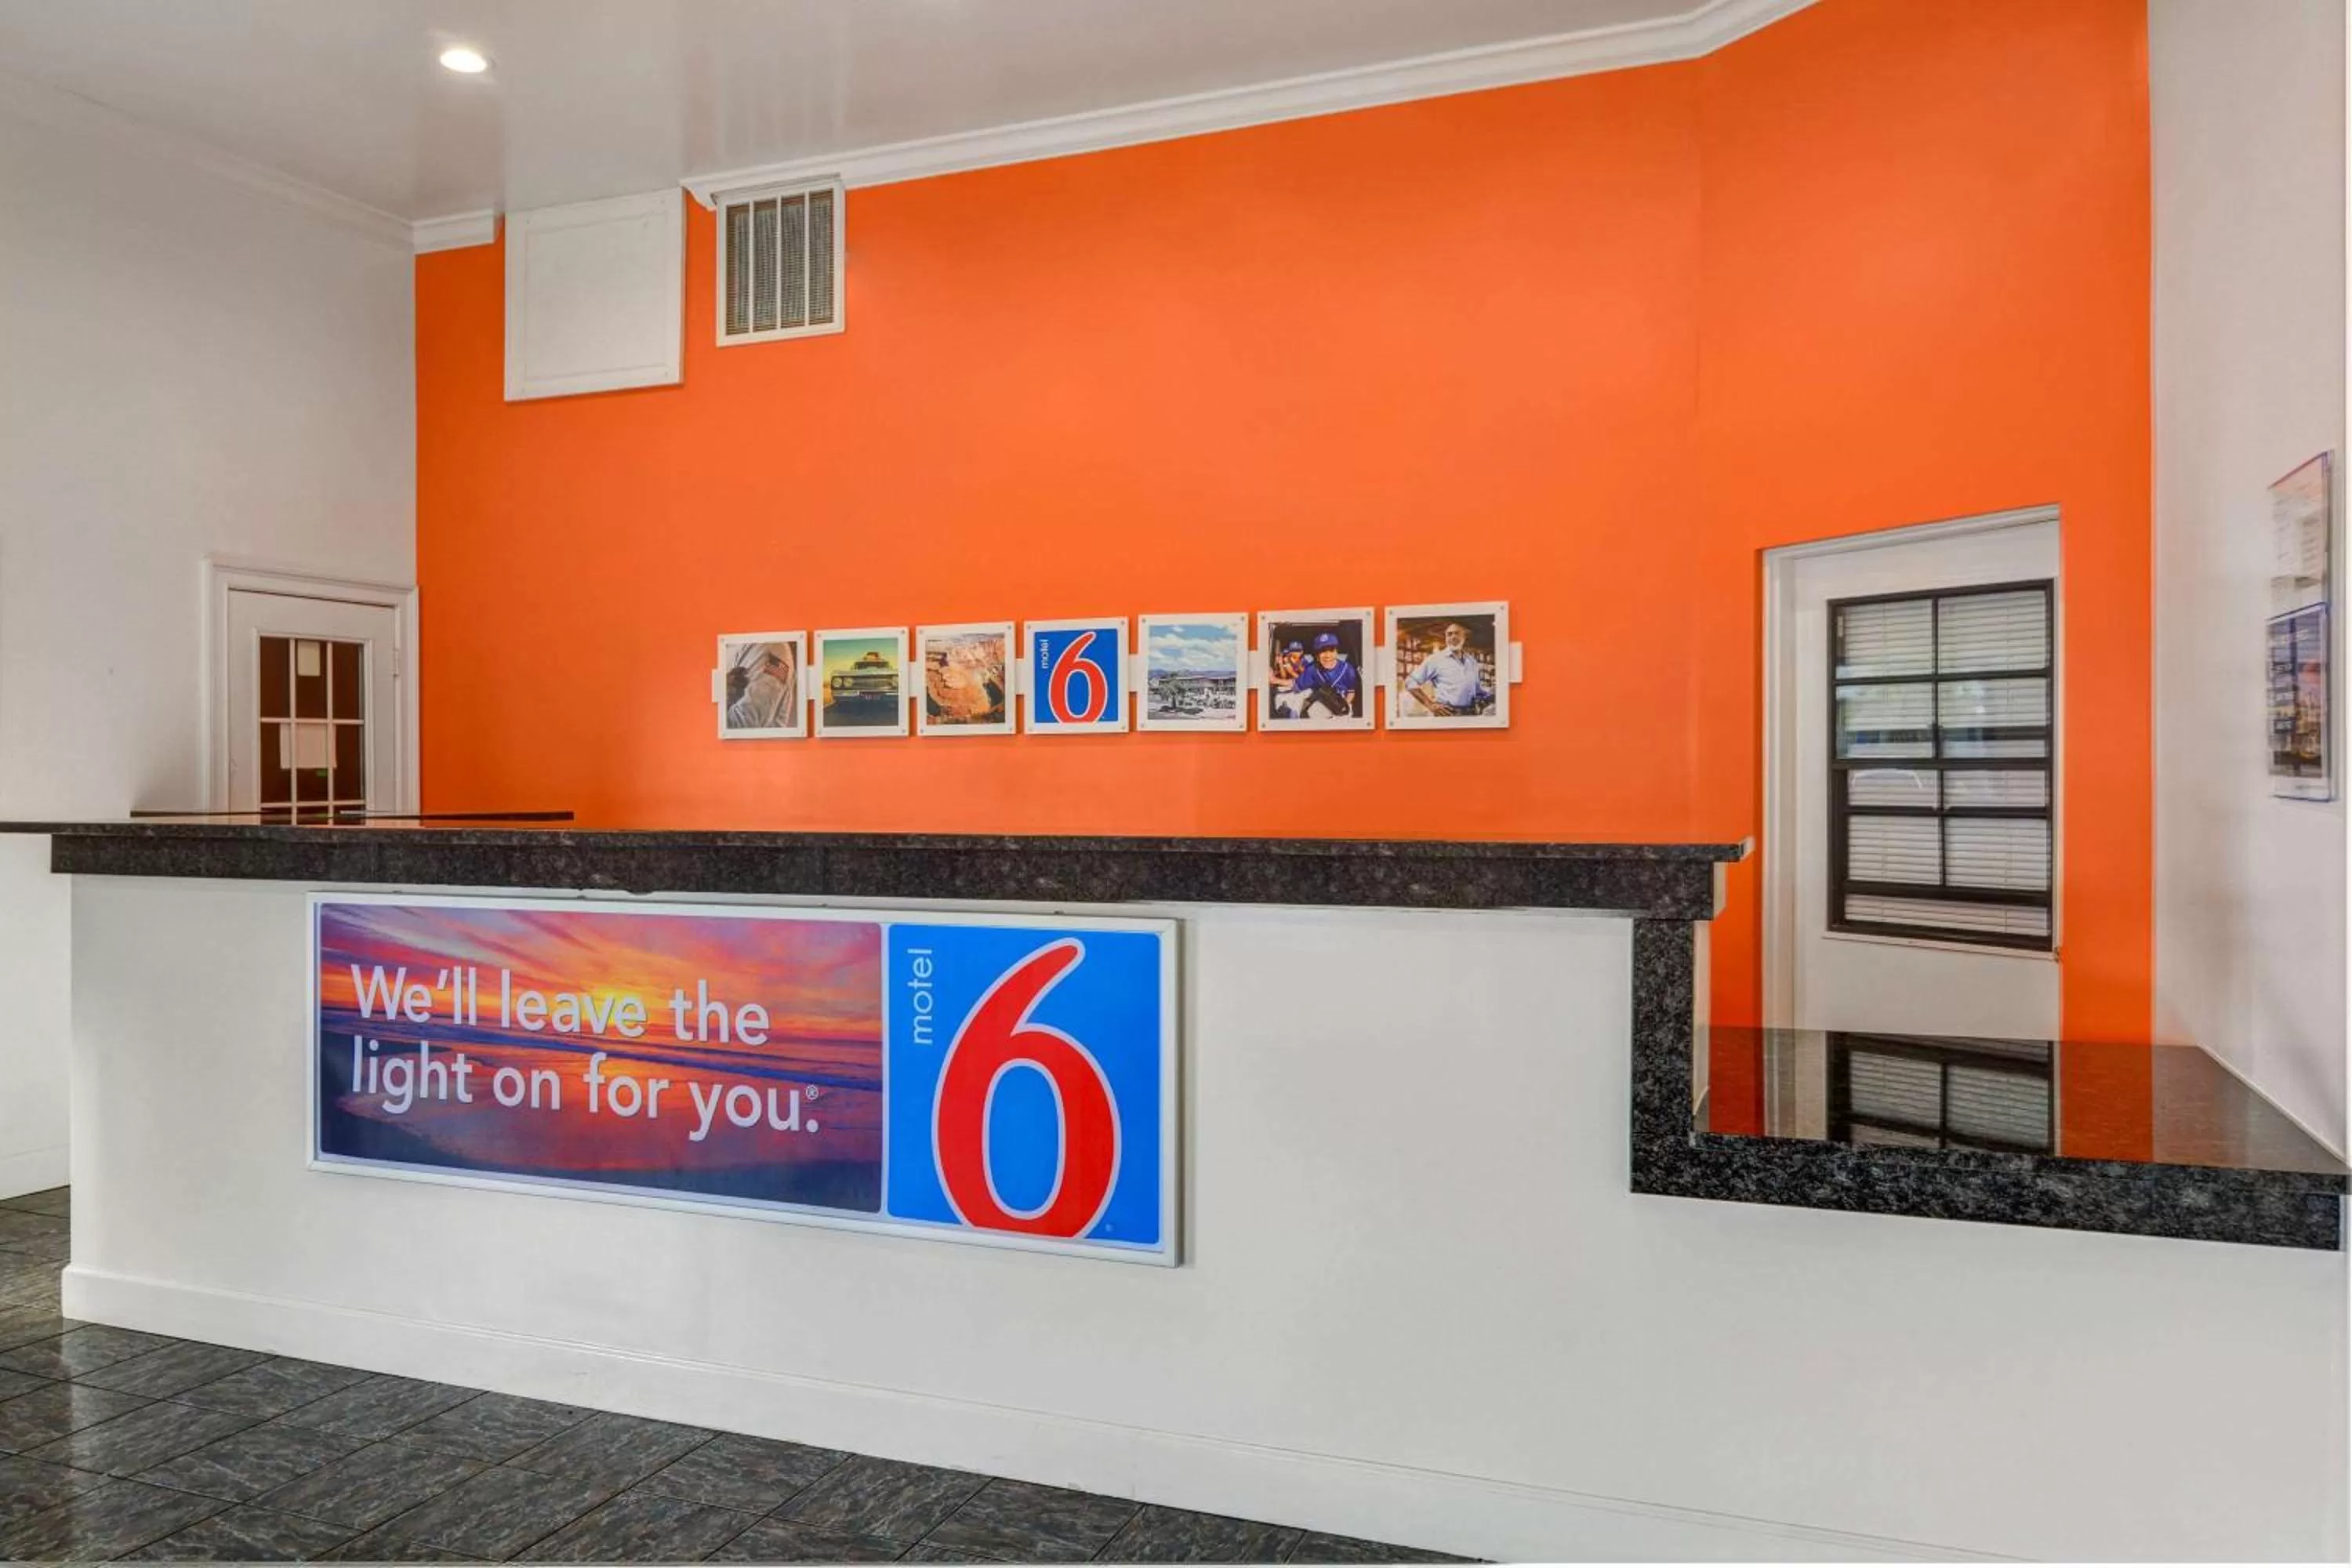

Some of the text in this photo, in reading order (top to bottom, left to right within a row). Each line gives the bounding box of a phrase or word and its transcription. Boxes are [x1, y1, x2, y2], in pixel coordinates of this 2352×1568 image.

[1048, 631, 1108, 724] 6
[351, 964, 770, 1046] We'll leave the
[352, 1034, 473, 1115] light
[492, 1066, 561, 1111] on
[583, 1051, 670, 1118] for
[907, 937, 1122, 1240] motel 6
